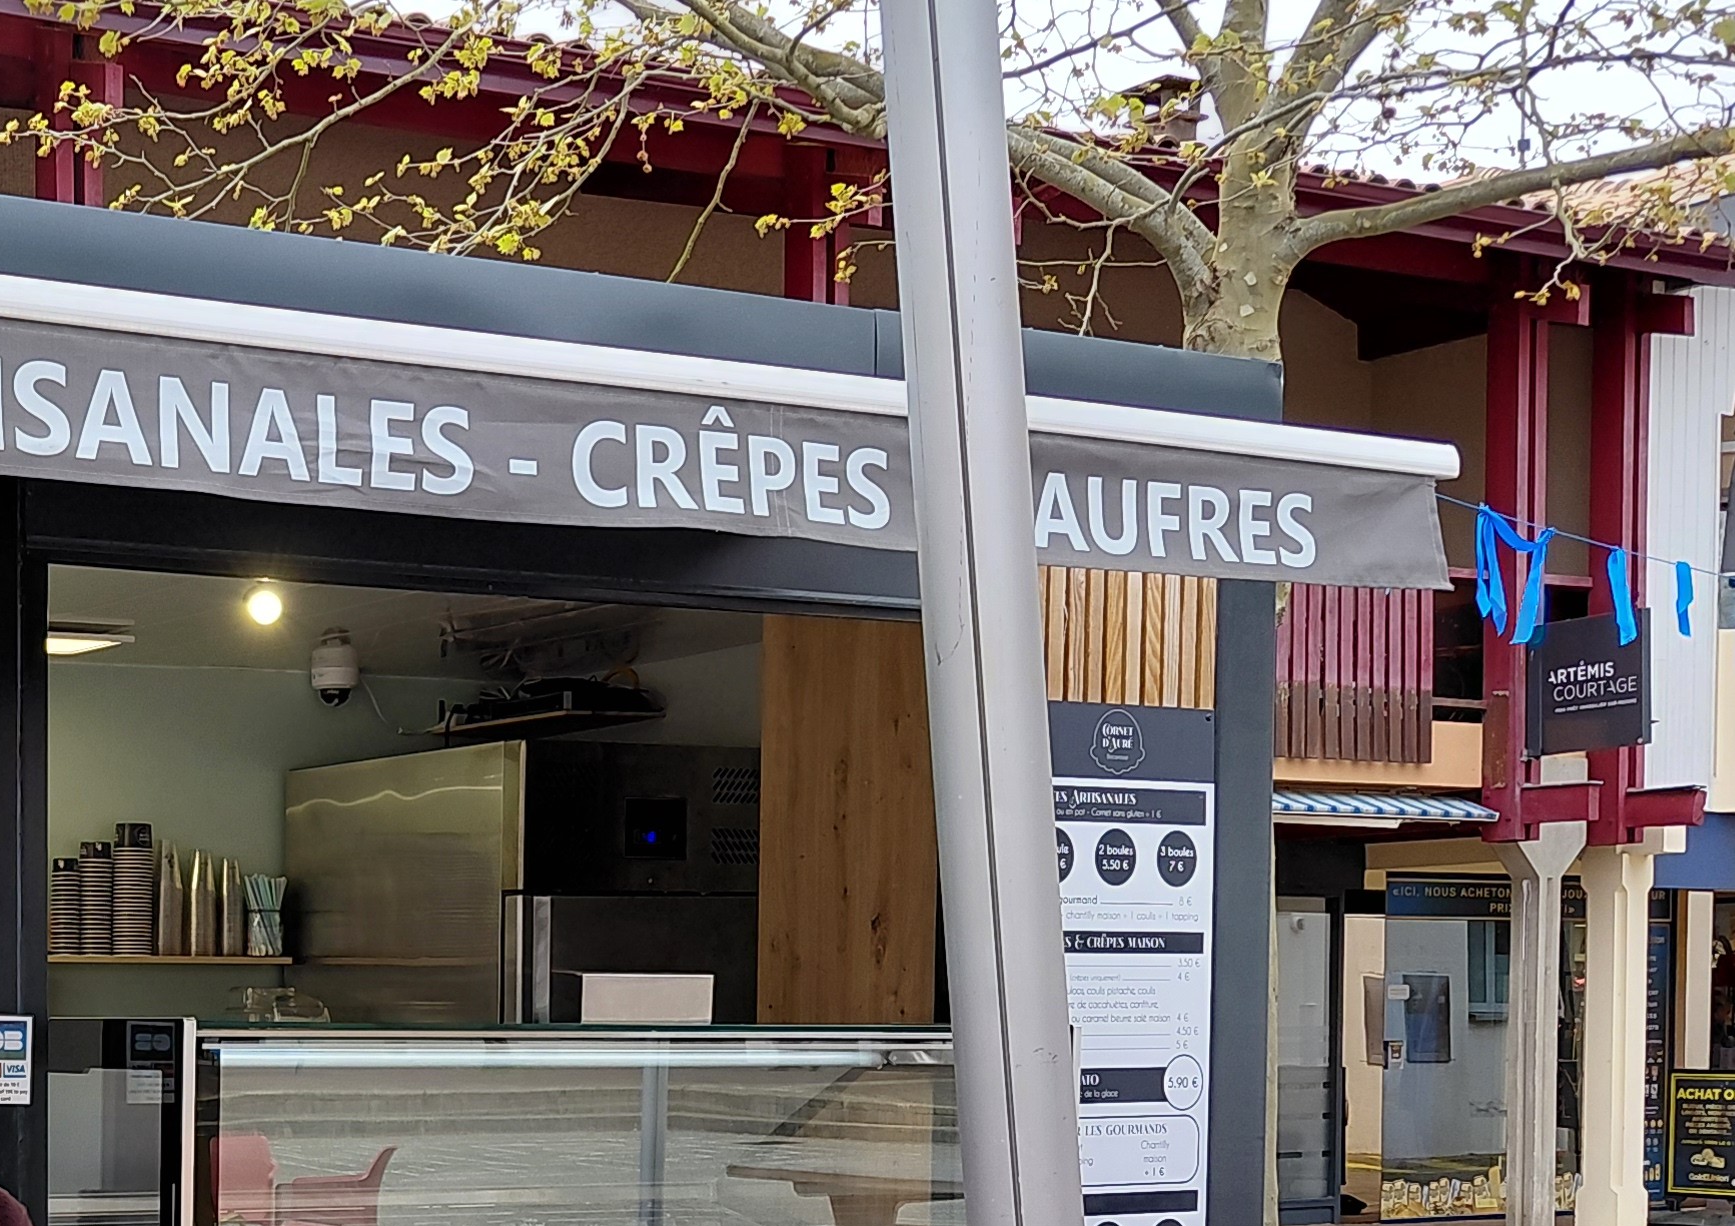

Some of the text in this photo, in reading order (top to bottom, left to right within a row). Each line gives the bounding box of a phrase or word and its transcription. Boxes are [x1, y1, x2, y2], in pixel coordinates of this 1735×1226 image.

[507, 458, 538, 476] -
[572, 405, 890, 530] CRÊPES
[1035, 472, 1316, 568] AUFRES
[1553, 676, 1637, 701] COURTAGE
[1069, 789, 1137, 808] ARTISANALES
[1057, 844, 1069, 854] ule
[1098, 844, 1133, 856] 2 boules
[1160, 846, 1194, 858] 3 boules
[1102, 859, 1129, 870] 5.50 €
[1169, 861, 1184, 872] 7 €
[1425, 887, 1456, 897] NOUS
[1087, 933, 1125, 948] CRÊPES
[1127, 937, 1166, 948] MAISON
[7, 1065, 25, 1073] VISA
[1168, 1077, 1198, 1088] 5.90 €
[1677, 1088, 1735, 1100] ACHAT O
[1085, 1123, 1167, 1136] LES GOURMANDS
[1159, 1166, 1165, 1176] €
